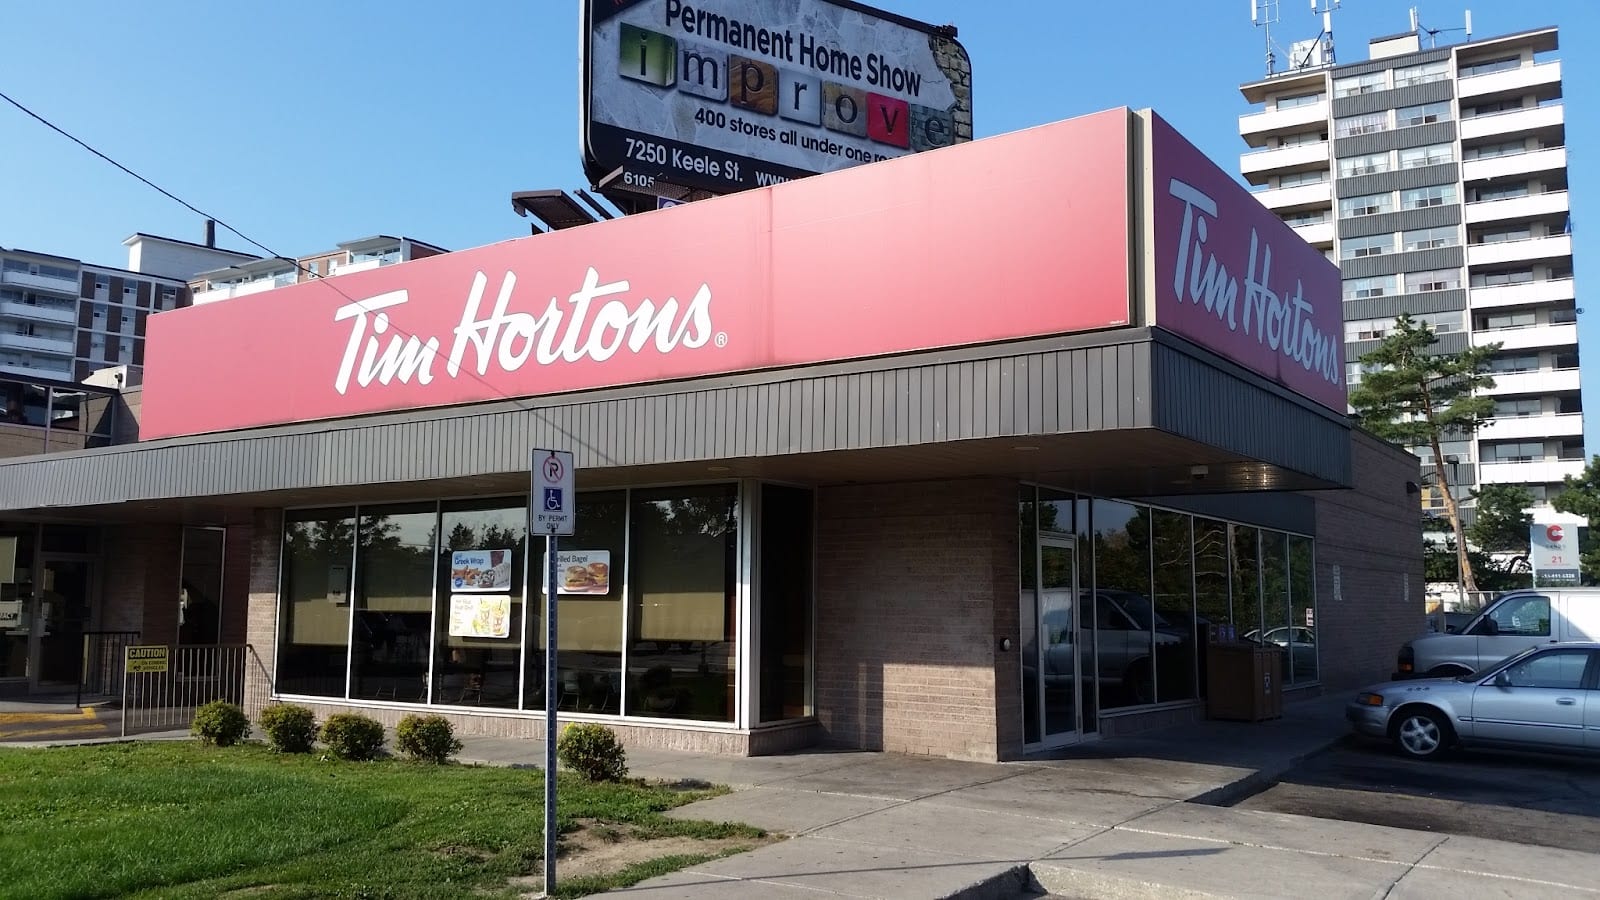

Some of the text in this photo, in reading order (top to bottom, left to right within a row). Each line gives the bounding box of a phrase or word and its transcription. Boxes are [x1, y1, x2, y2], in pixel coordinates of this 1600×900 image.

[665, 0, 922, 97] Permanent Home Show
[694, 107, 726, 129] 400
[729, 117, 777, 141] stores
[779, 129, 798, 146] all
[801, 136, 843, 157] under
[845, 146, 872, 163] one
[624, 137, 667, 166] 7250
[672, 148, 721, 177] Keele
[724, 160, 744, 183] St.
[623, 171, 656, 188] 6105
[1169, 178, 1340, 386] Tim Hortons
[334, 288, 440, 396] Tim
[446, 266, 713, 379] Hortons
[538, 514, 545, 522] BY
[546, 522, 560, 530] ONLY
[1551, 556, 1562, 564] 21
[130, 649, 165, 658] CAUTION
